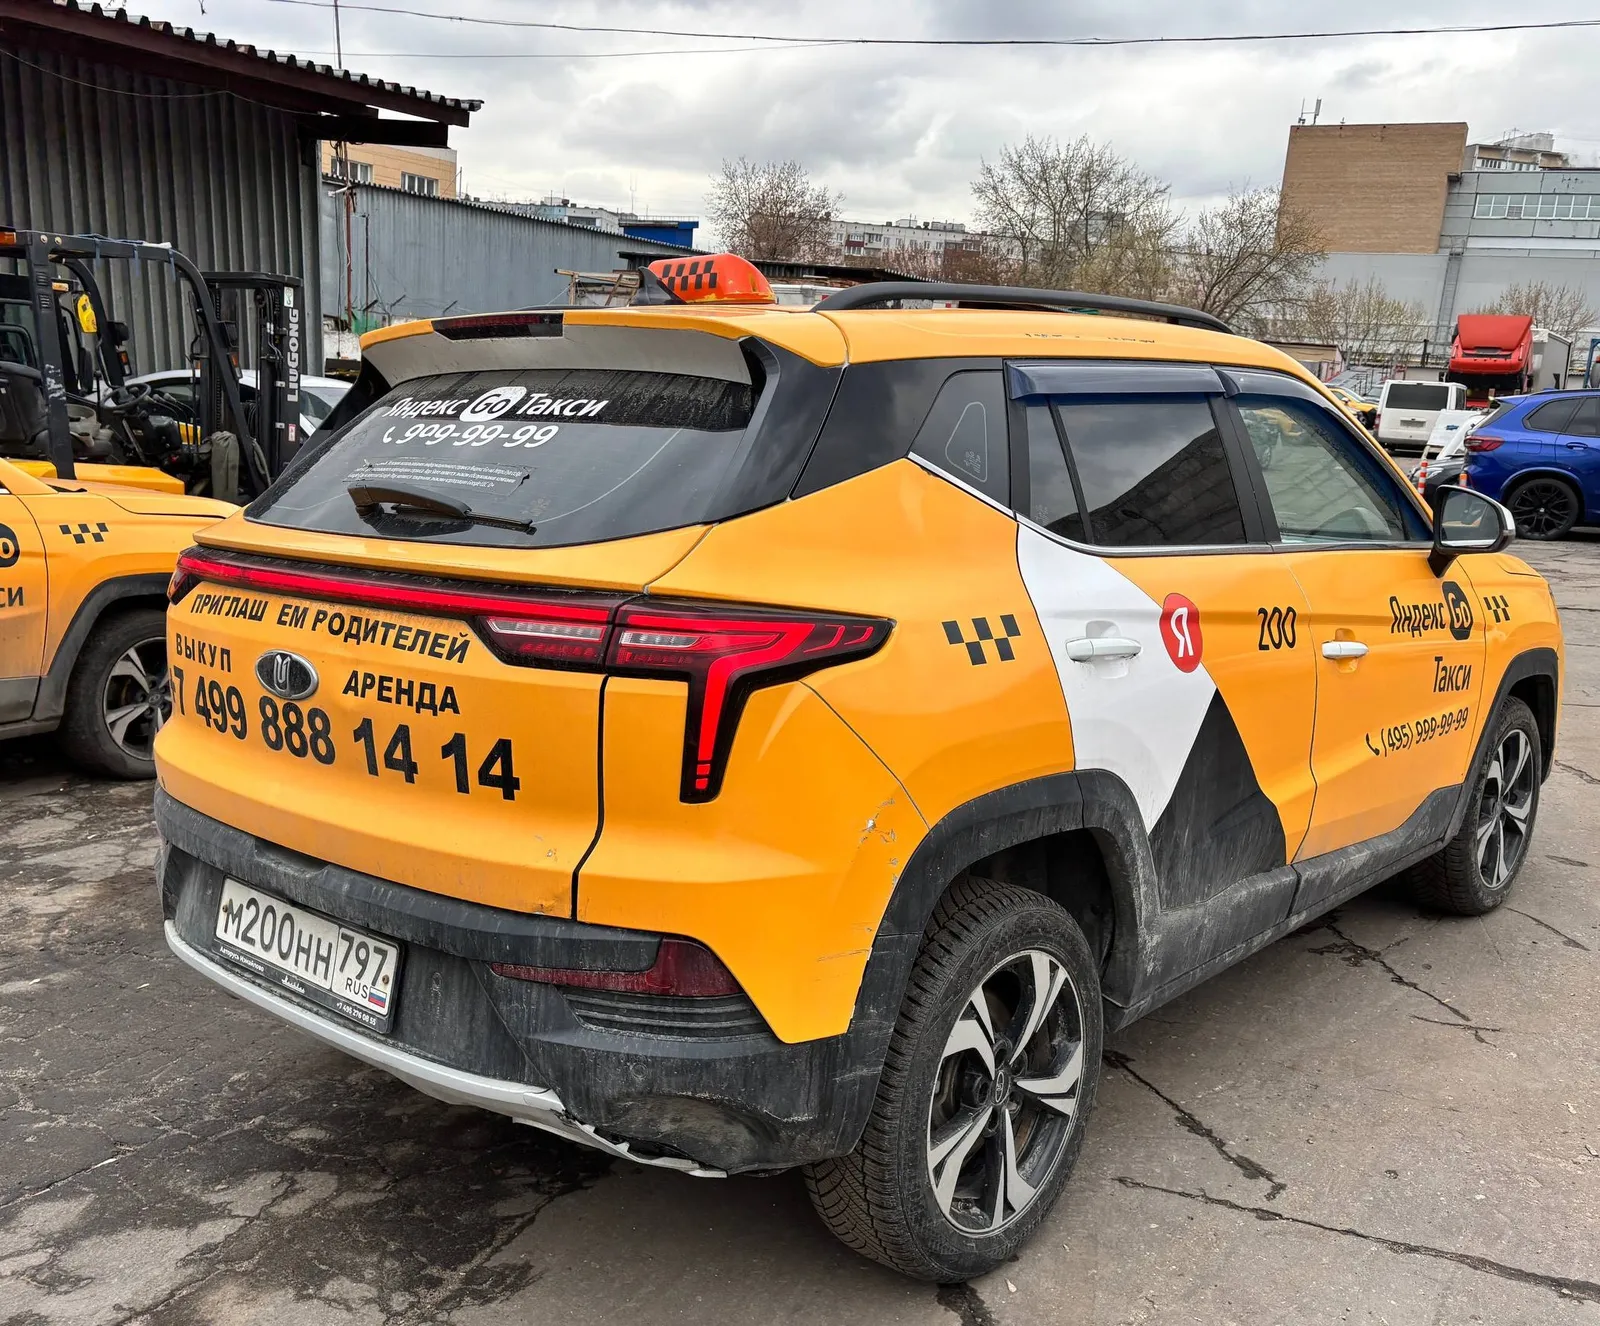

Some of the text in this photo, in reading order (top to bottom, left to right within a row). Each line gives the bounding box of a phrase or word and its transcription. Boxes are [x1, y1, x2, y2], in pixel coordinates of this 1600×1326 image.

[287, 309, 299, 402] LIUGONG
[382, 397, 469, 419] Яндекс
[516, 393, 609, 417] Такси
[190, 594, 471, 664] ПРИГЛАШ ЕМ РОДИТЕЛЕЙ
[1171, 606, 1194, 658] Я
[1258, 606, 1297, 651] 200
[1390, 595, 1446, 638] Яндекс
[176, 632, 231, 673] ВЫКУП
[1433, 656, 1472, 693] Такси
[342, 670, 460, 717] АРЕНДА
[195, 675, 248, 740] 499
[259, 695, 336, 765] 888
[353, 717, 419, 784] 14
[441, 732, 521, 801] 14
[1381, 707, 1469, 757] (495) 999-99-99
[339, 933, 389, 987] 797
[345, 977, 369, 999] RUS
